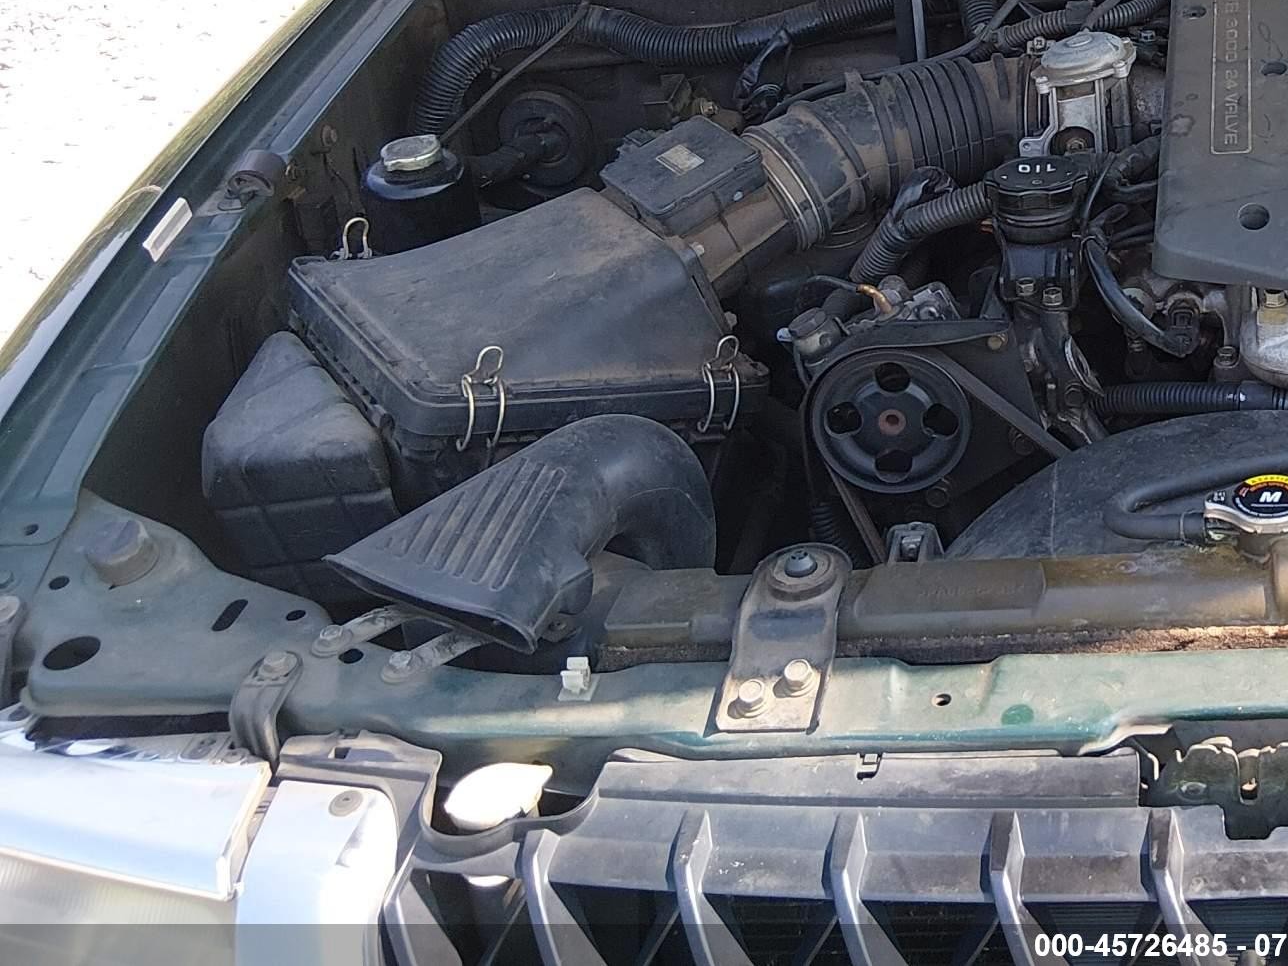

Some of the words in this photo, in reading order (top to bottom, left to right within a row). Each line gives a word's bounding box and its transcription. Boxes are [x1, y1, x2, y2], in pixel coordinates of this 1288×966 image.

[1225, 17, 1239, 63] 3000
[1222, 92, 1239, 146] VALVE
[1018, 163, 1056, 173] OIL
[1259, 491, 1282, 503] M
